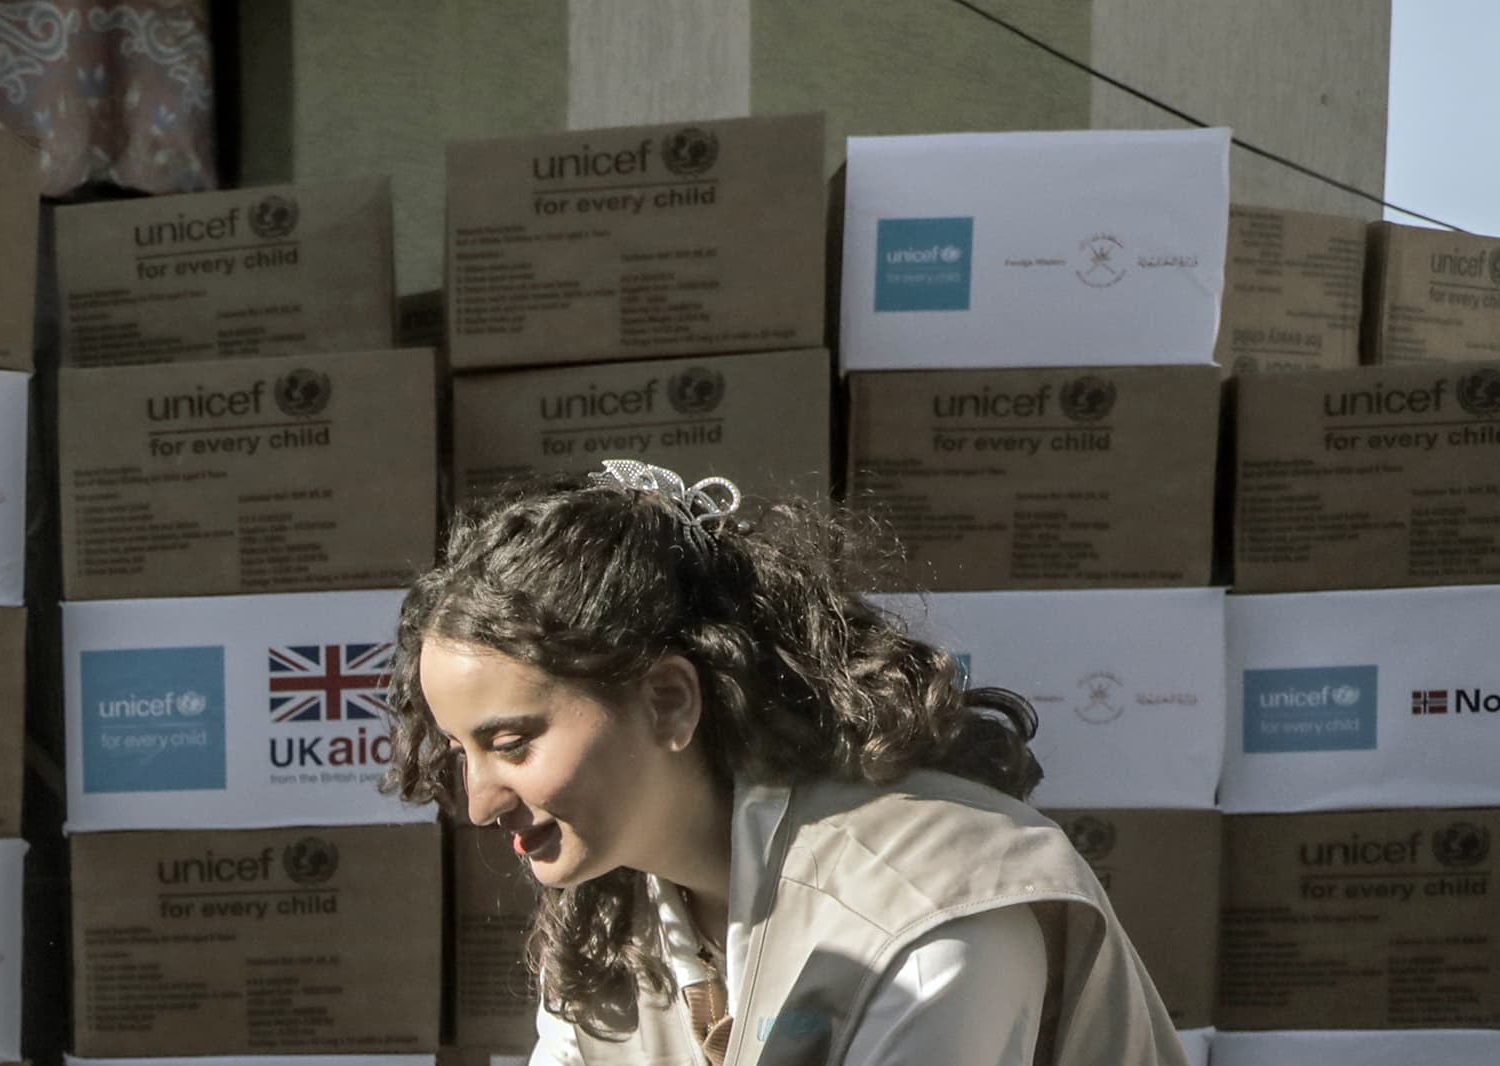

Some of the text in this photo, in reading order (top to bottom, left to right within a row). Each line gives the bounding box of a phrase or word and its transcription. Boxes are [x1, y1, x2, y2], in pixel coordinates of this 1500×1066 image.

[532, 139, 653, 181] unicef
[532, 186, 717, 215] for every child
[134, 207, 240, 249] unicef
[137, 247, 298, 280] for every child
[885, 244, 941, 265] unicef
[1430, 247, 1487, 277] unicef
[1429, 287, 1446, 302] for
[146, 380, 266, 423] unicef
[539, 378, 659, 422] unicef
[932, 384, 1052, 419] unicef
[1324, 377, 1448, 417] unicef
[148, 427, 331, 457] for every child
[542, 425, 723, 456] for every child
[932, 432, 1111, 456] for every child
[1324, 432, 1361, 451] for
[1367, 431, 1438, 451] every
[98, 692, 176, 719] unicef
[1259, 687, 1328, 708] unicef
[1299, 830, 1422, 867] unicef
[158, 847, 274, 886] unicef
[1301, 876, 1487, 901] for every child
[159, 894, 337, 920] for every child
